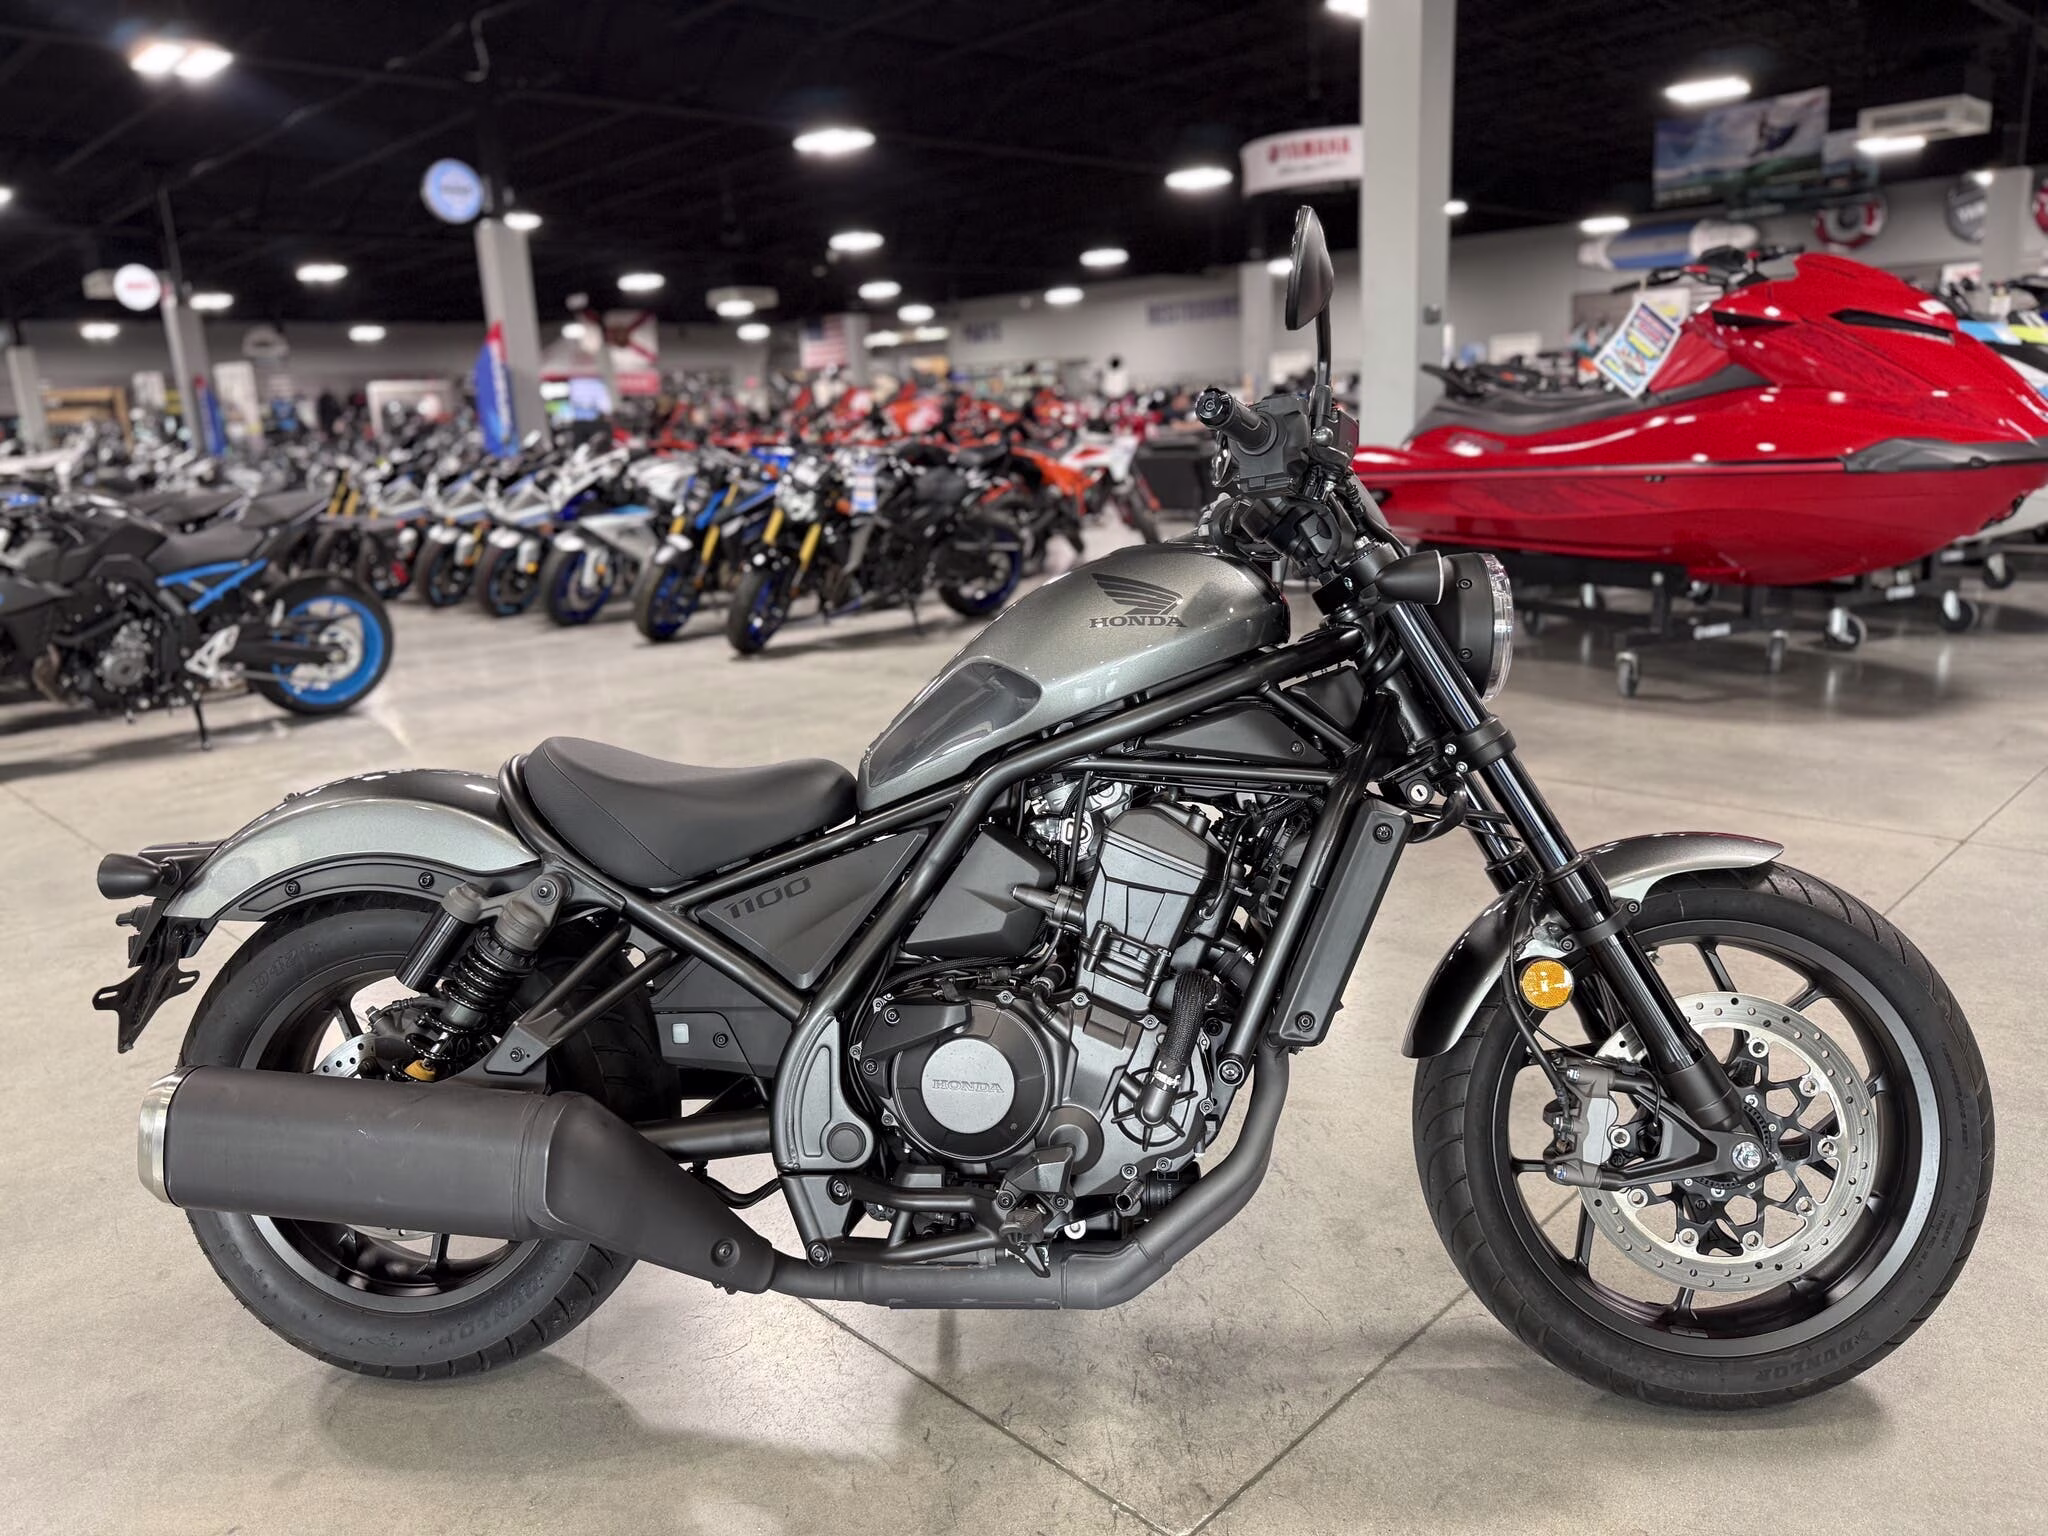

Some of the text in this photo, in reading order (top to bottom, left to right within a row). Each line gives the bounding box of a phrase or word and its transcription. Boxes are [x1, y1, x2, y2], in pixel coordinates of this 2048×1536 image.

[1089, 615, 1187, 628] HONDA
[723, 876, 811, 919] 1100
[932, 1079, 1004, 1093] HONDA
